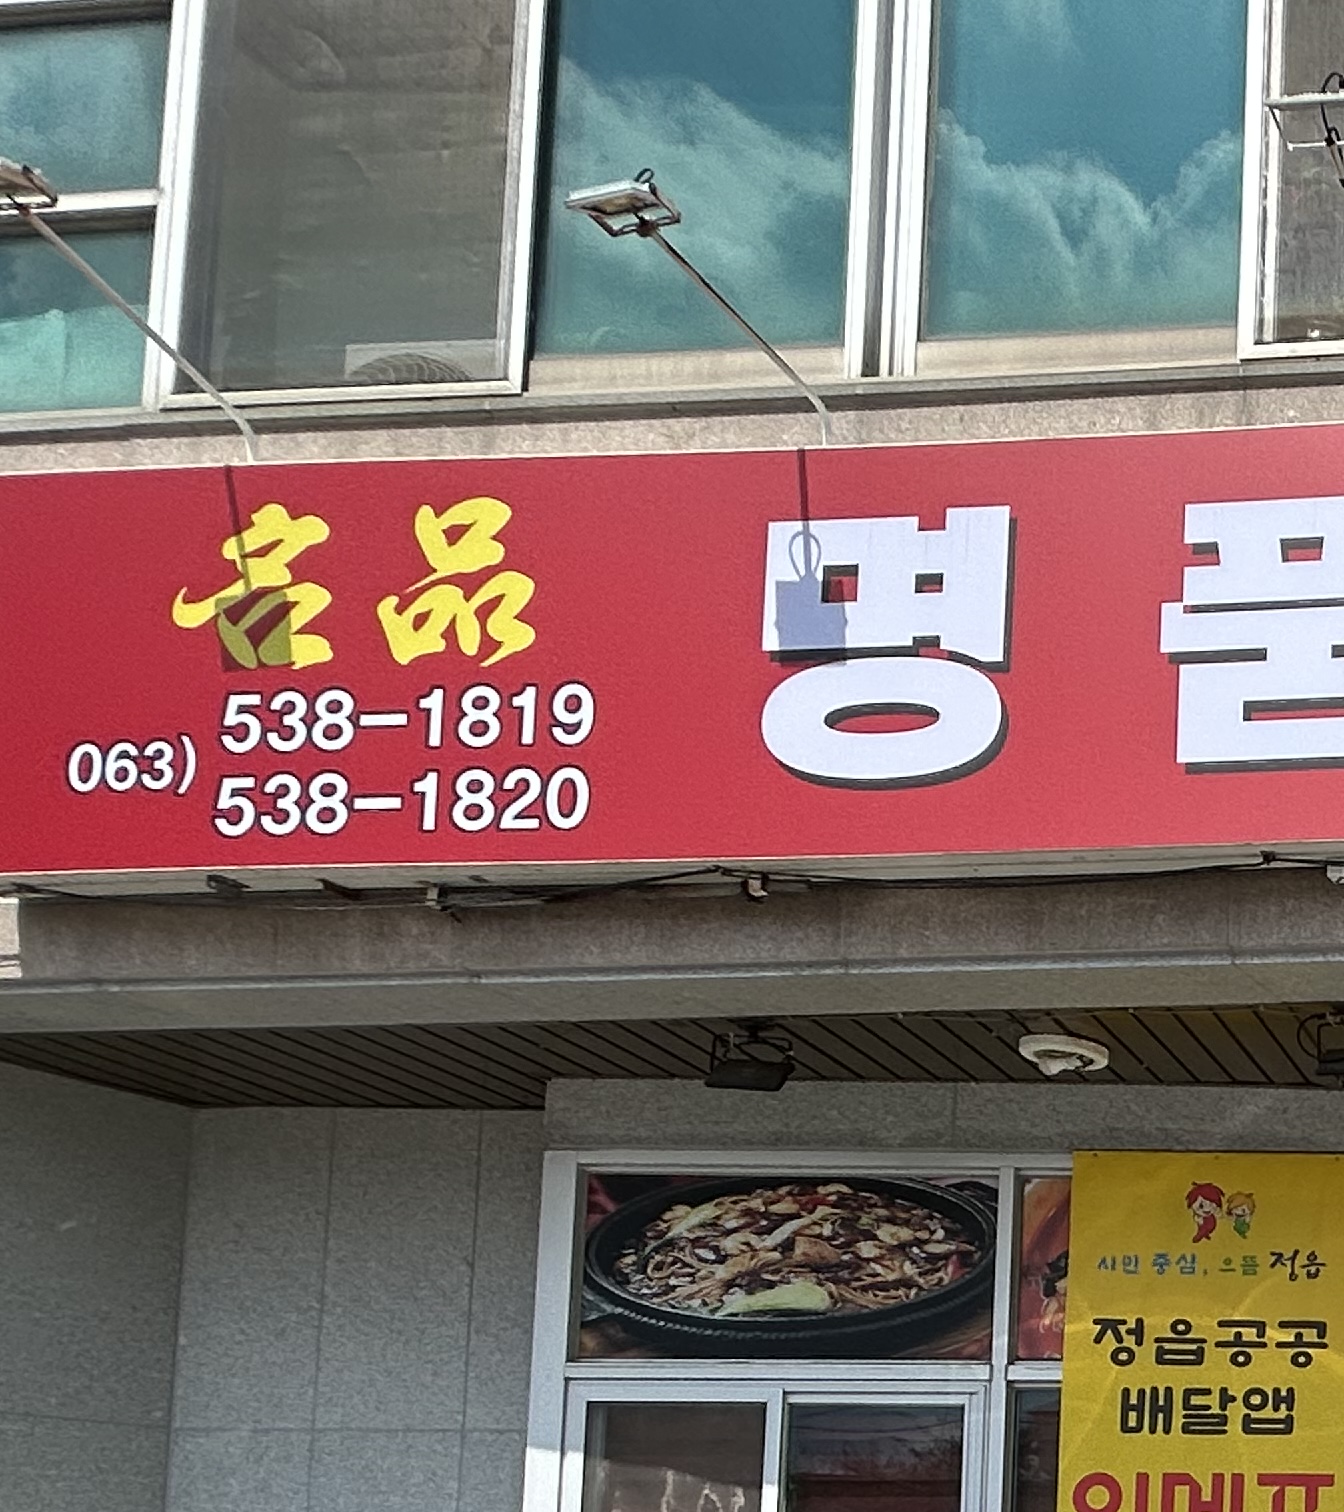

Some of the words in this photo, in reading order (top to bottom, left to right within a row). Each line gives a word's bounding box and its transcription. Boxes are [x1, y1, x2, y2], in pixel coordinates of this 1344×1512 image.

[219, 681, 596, 755] 538-1819
[66, 735, 198, 795] 063)
[212, 765, 591, 838] 538-1820
[1097, 1254, 1140, 1275] 시민
[1218, 1254, 1260, 1277] 으뜸
[1268, 1249, 1326, 1281] 정읍
[1092, 1317, 1329, 1368] 정읍공공
[1119, 1386, 1296, 1435] 배달앱
